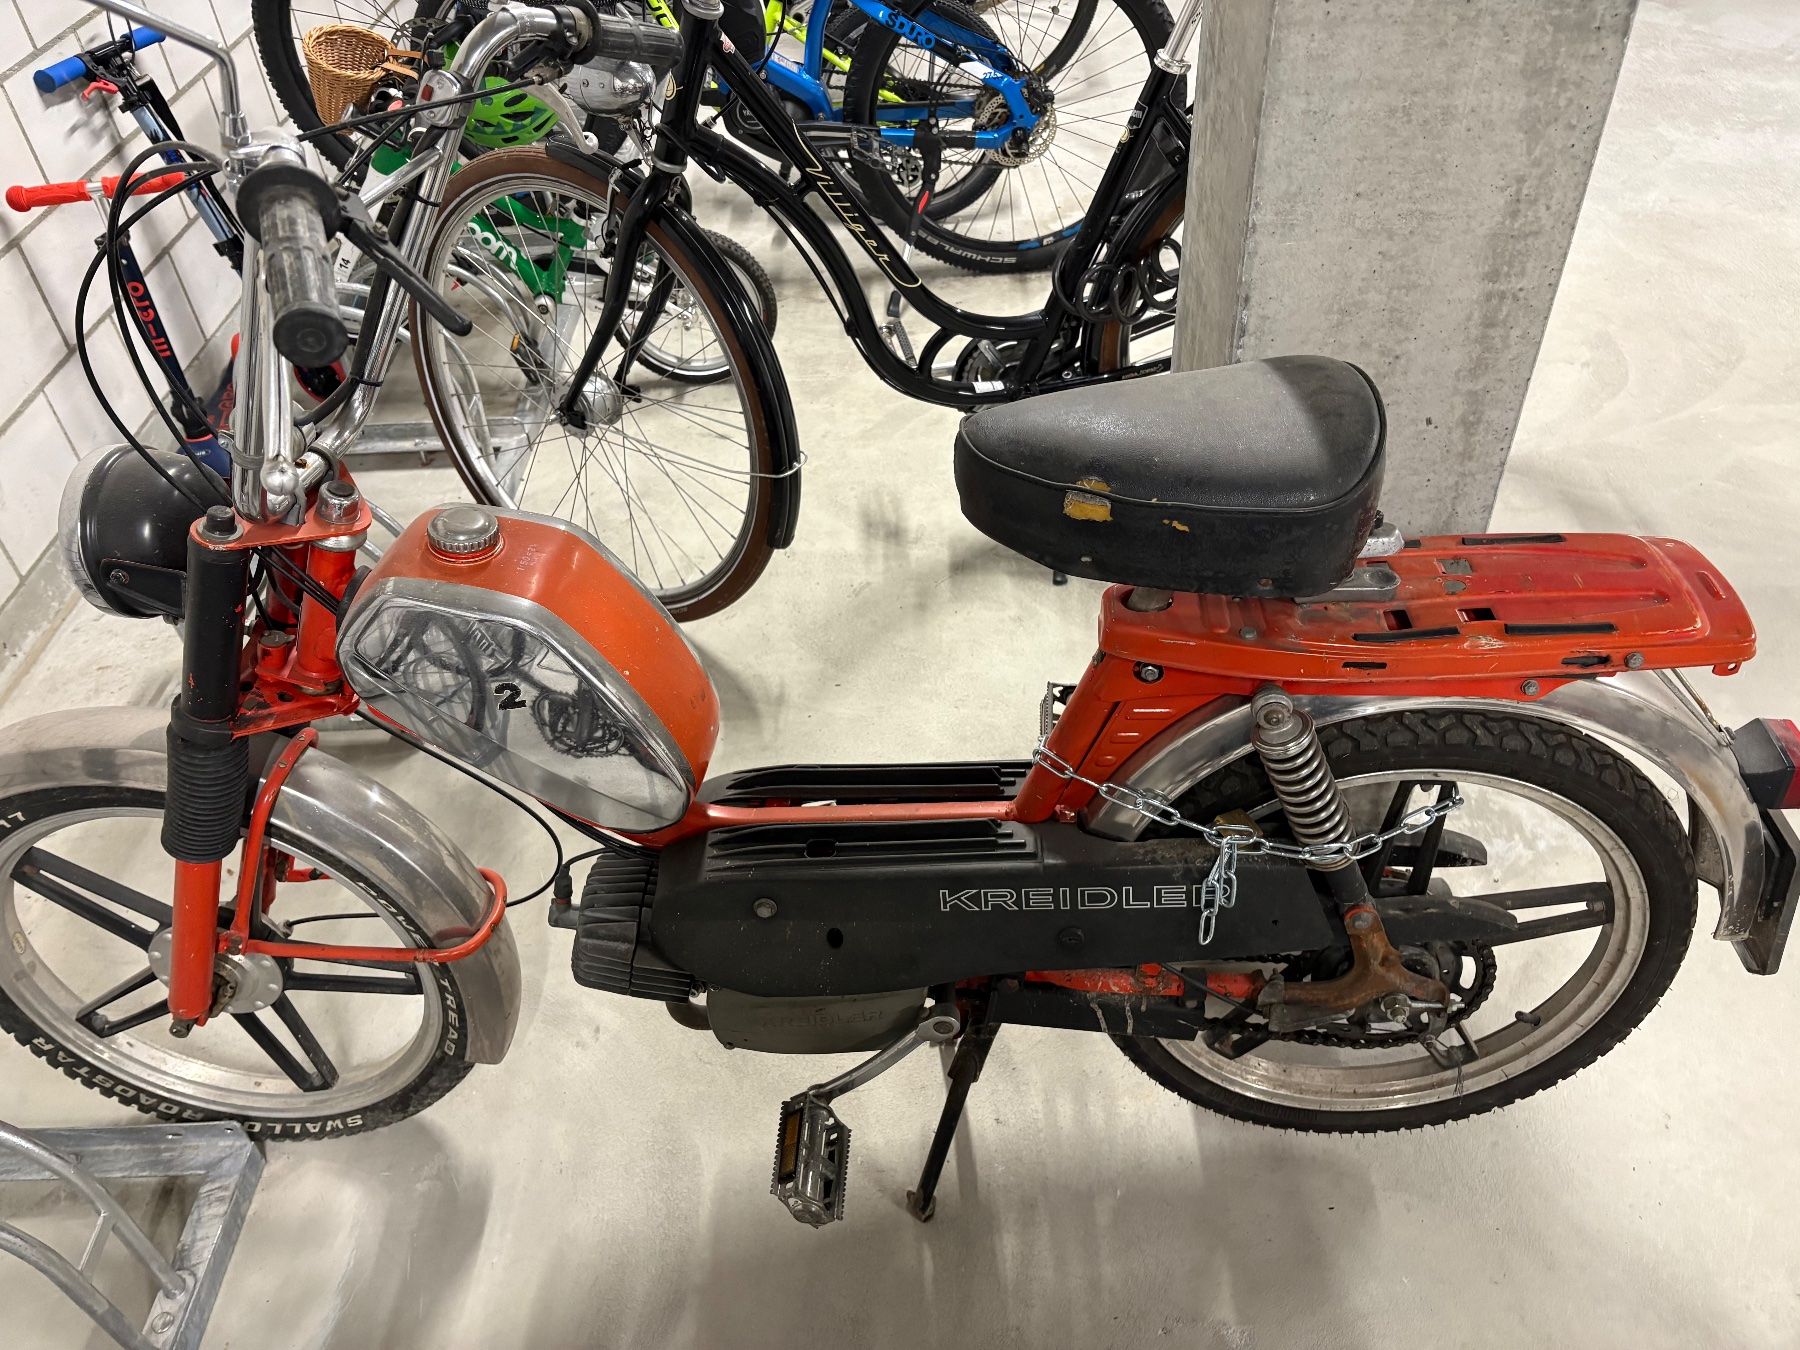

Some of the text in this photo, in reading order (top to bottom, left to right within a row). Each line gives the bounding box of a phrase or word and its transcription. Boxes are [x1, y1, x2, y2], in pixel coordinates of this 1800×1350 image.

[885, 11, 936, 49] SDURO
[339, 257, 351, 269] 14
[467, 222, 517, 270] oom
[494, 682, 527, 710] 2
[940, 885, 1232, 911] KREIDLER
[356, 881, 461, 1056] POWE TREAD
[31, 1036, 364, 1135] SWALLO ROADSTAR
